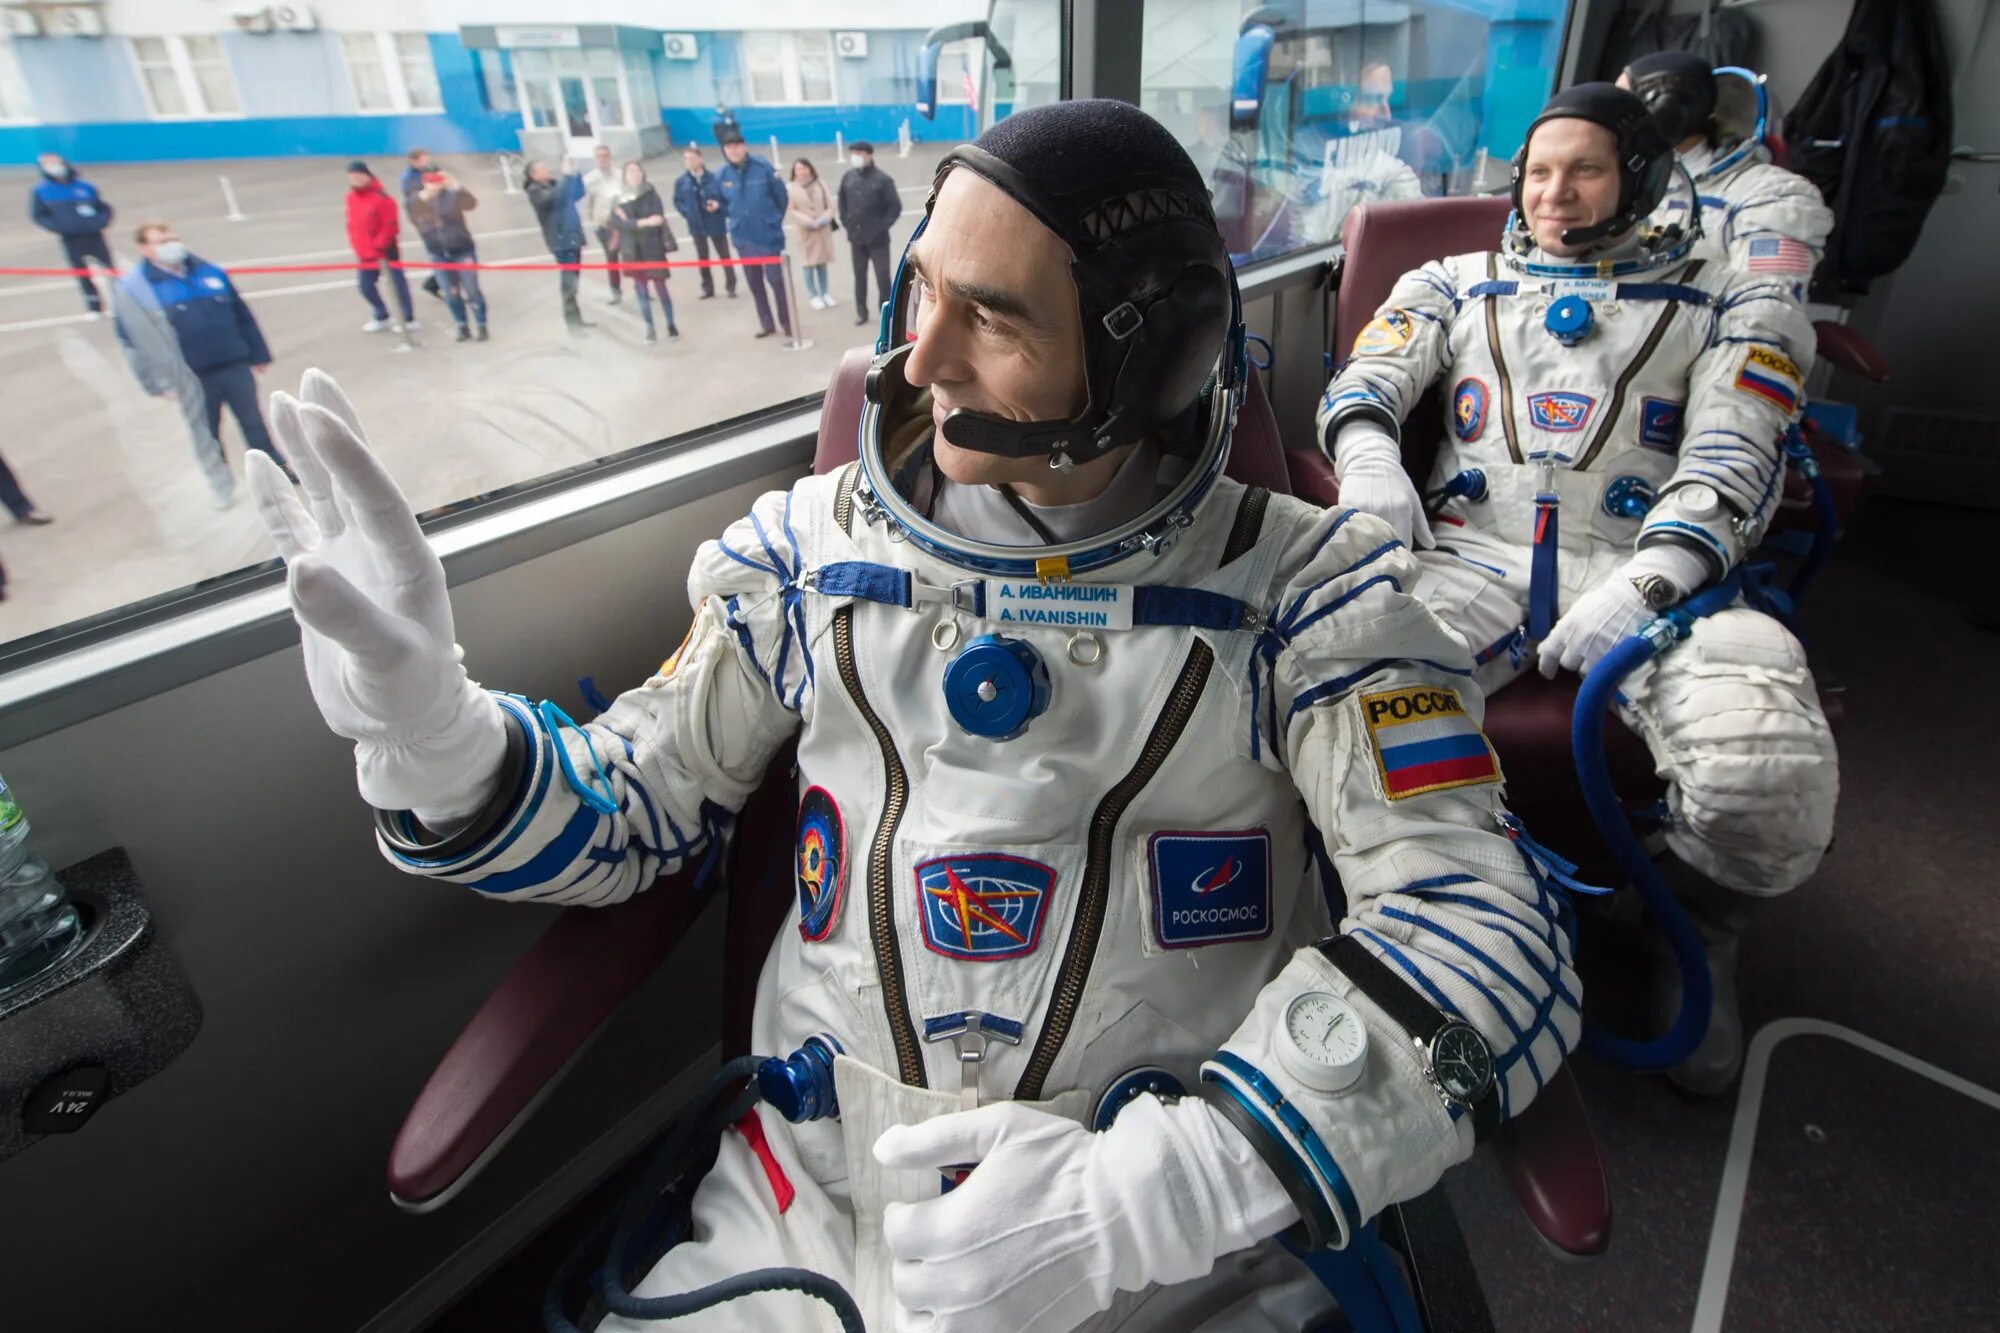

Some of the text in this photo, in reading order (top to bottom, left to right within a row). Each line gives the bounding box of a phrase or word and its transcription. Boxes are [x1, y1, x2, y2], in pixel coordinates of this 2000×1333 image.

[1000, 584, 1117, 602] А. ИВАНИШИН
[1000, 608, 1107, 626] A. IVANISHIN
[1172, 905, 1258, 925] РОСКОСМОС
[50, 1101, 88, 1113] 24 V
